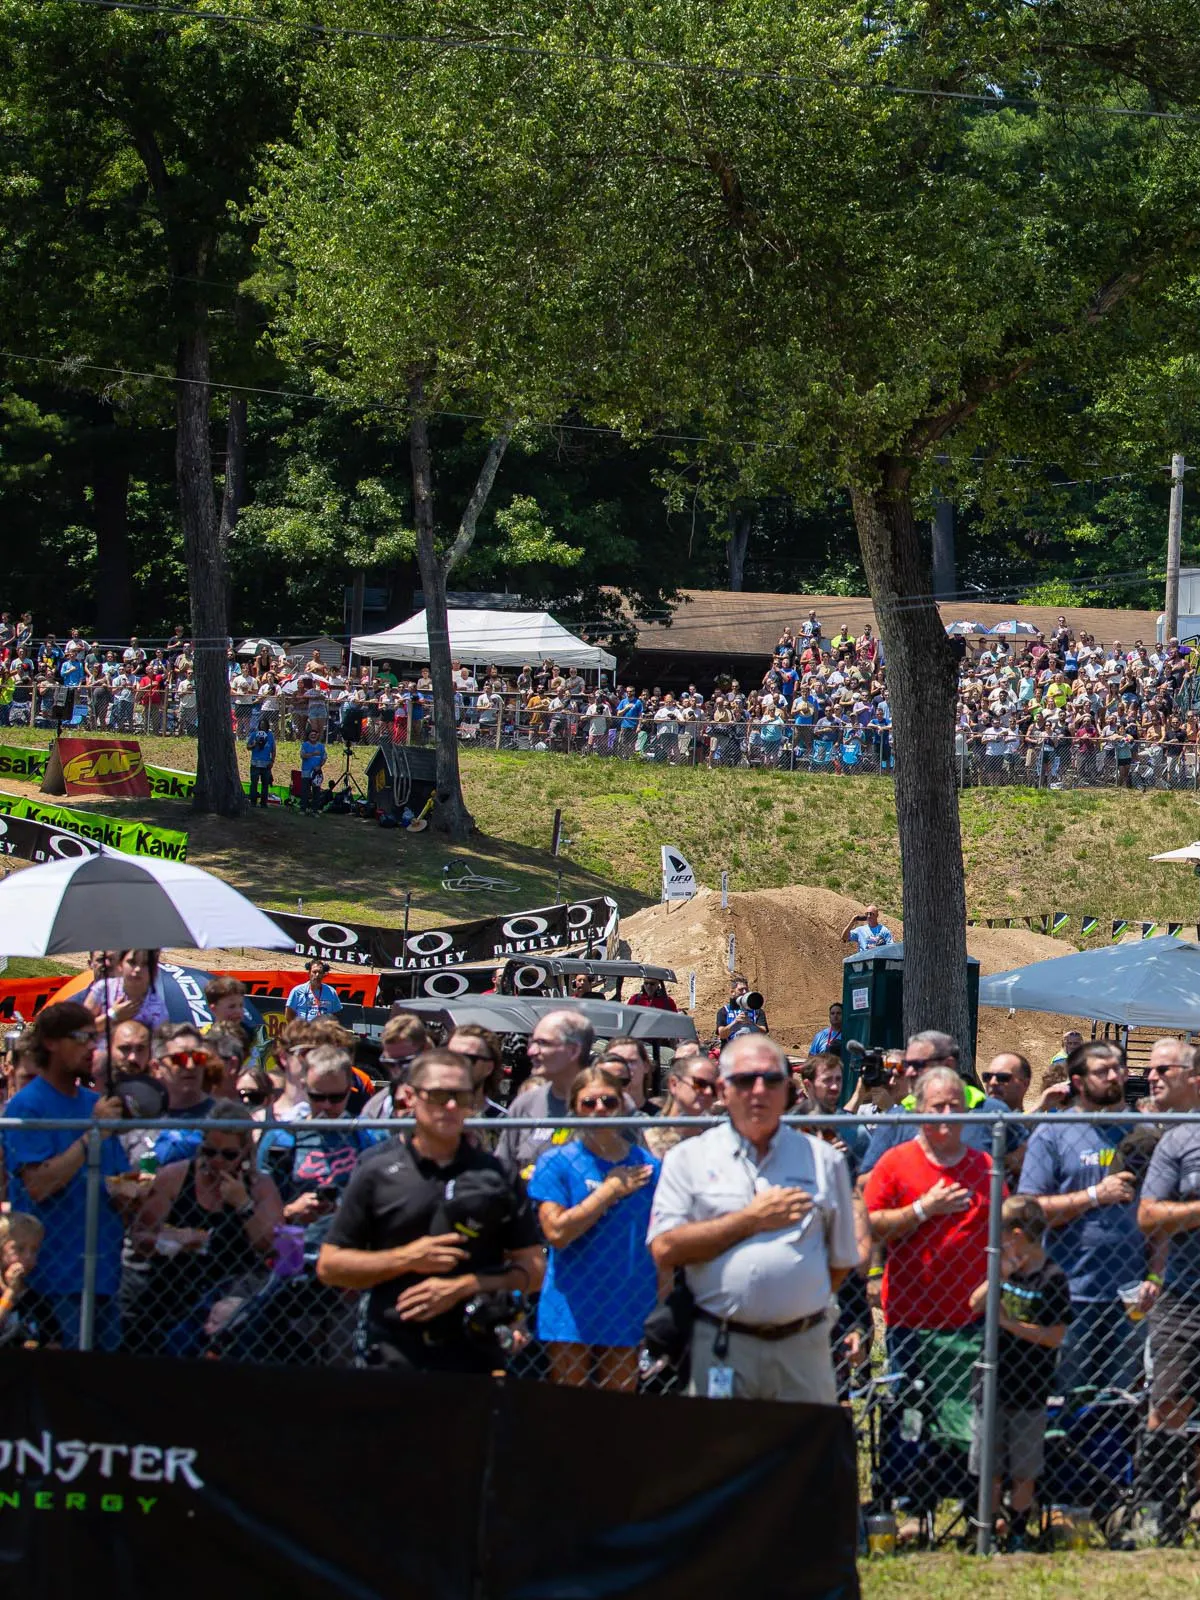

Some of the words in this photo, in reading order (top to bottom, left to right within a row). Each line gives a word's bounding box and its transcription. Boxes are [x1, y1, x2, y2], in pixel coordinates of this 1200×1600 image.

[65, 751, 141, 782] FMF
[670, 874, 692, 882] UFO
[295, 943, 369, 964] OAKLEY
[494, 935, 561, 955] OAKLEY
[395, 951, 466, 969] OAKLEY
